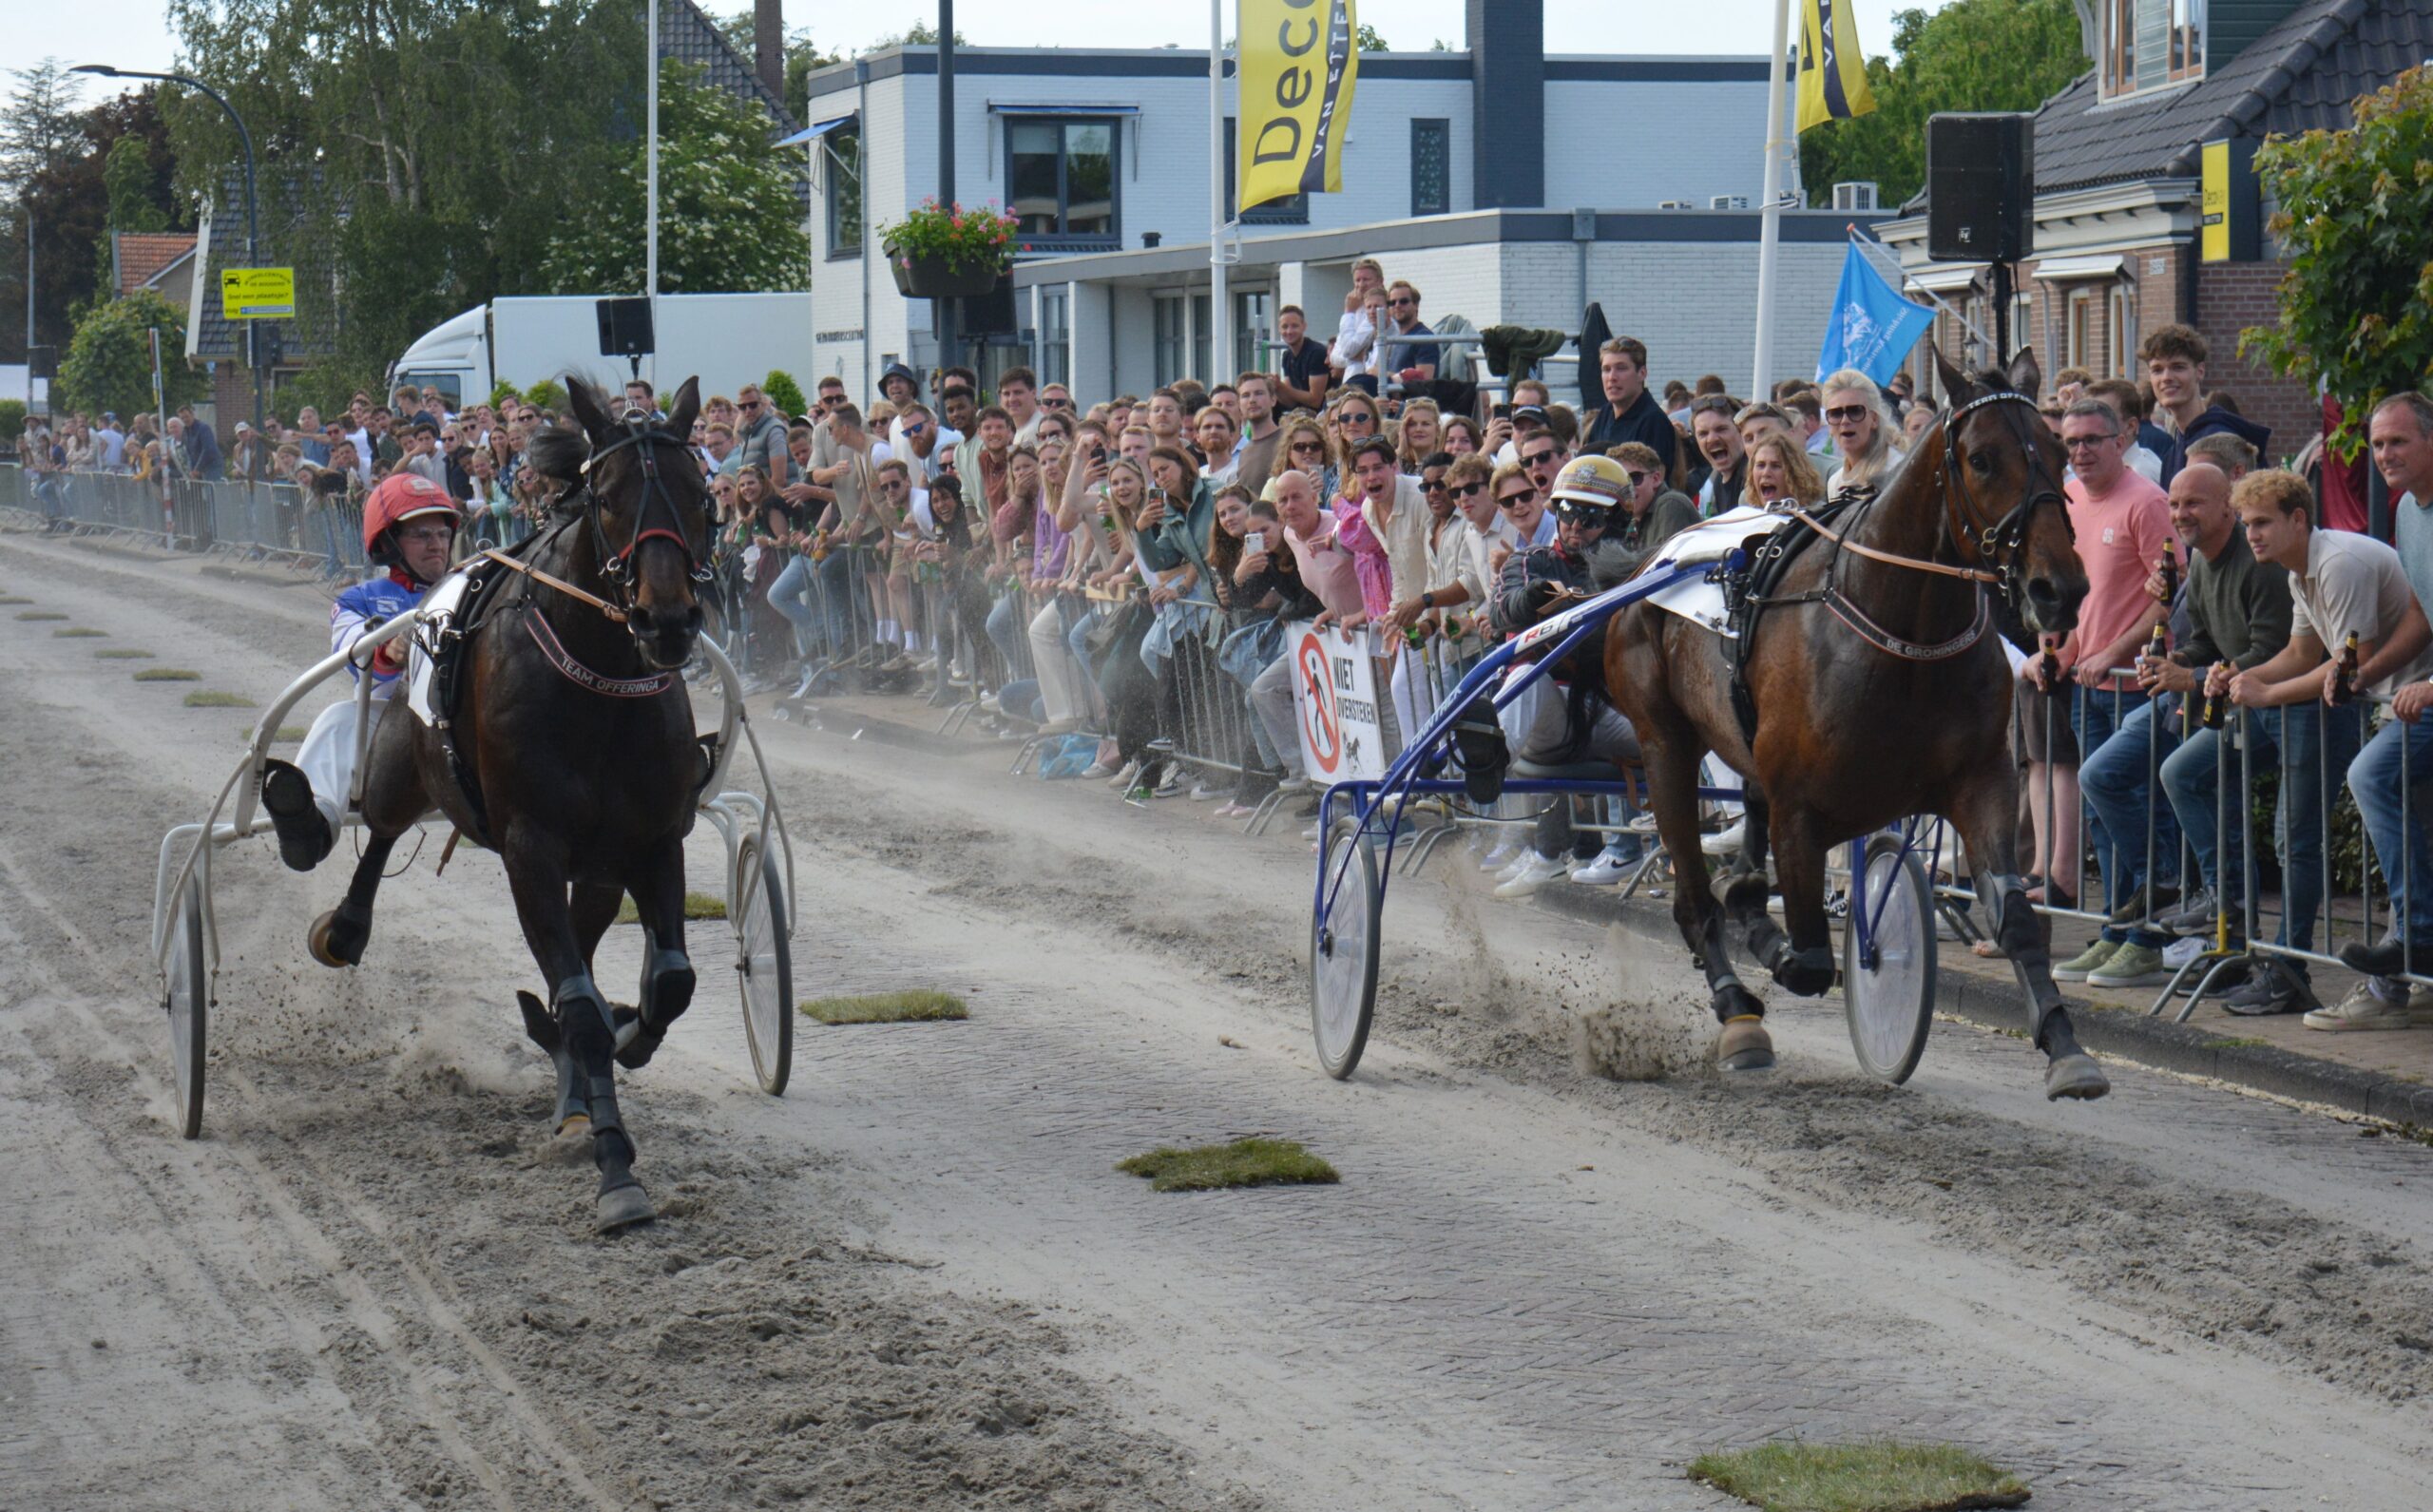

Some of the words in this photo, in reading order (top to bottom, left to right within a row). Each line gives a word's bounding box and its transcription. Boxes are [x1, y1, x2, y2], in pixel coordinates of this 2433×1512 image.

[1253, 0, 1319, 166] Dec
[1312, 100, 1334, 159] VAN
[1328, 0, 1348, 85] ETTE
[1887, 638, 1902, 653] DE
[1905, 629, 1976, 658] GRONINGERS
[562, 656, 594, 685] TEAM
[596, 679, 659, 694] OFFERINGA
[1332, 656, 1354, 692] NIET
[1336, 696, 1376, 725] OVERSTEKEN
